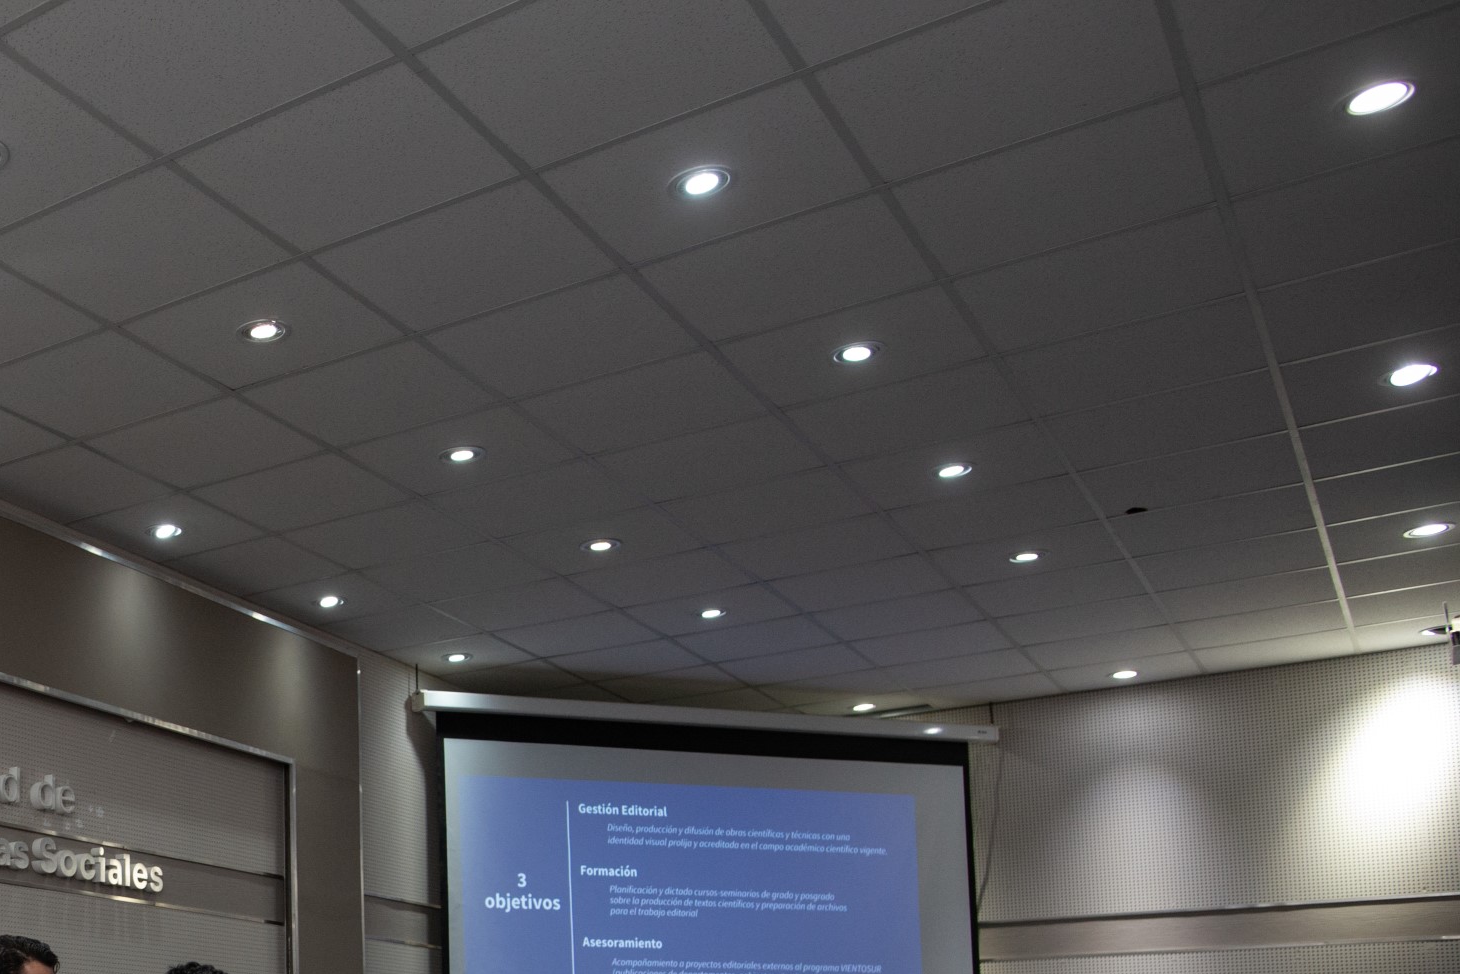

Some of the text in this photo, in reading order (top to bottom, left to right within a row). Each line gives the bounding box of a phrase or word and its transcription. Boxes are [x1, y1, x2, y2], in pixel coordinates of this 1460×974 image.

[30, 774, 76, 815] de
[578, 803, 667, 817] Gestión Editorial
[32, 837, 164, 893] Sociales
[580, 865, 638, 877] Formación
[517, 873, 527, 888] 3
[485, 893, 561, 913] objetivos
[582, 937, 662, 949] Asesoramiento
